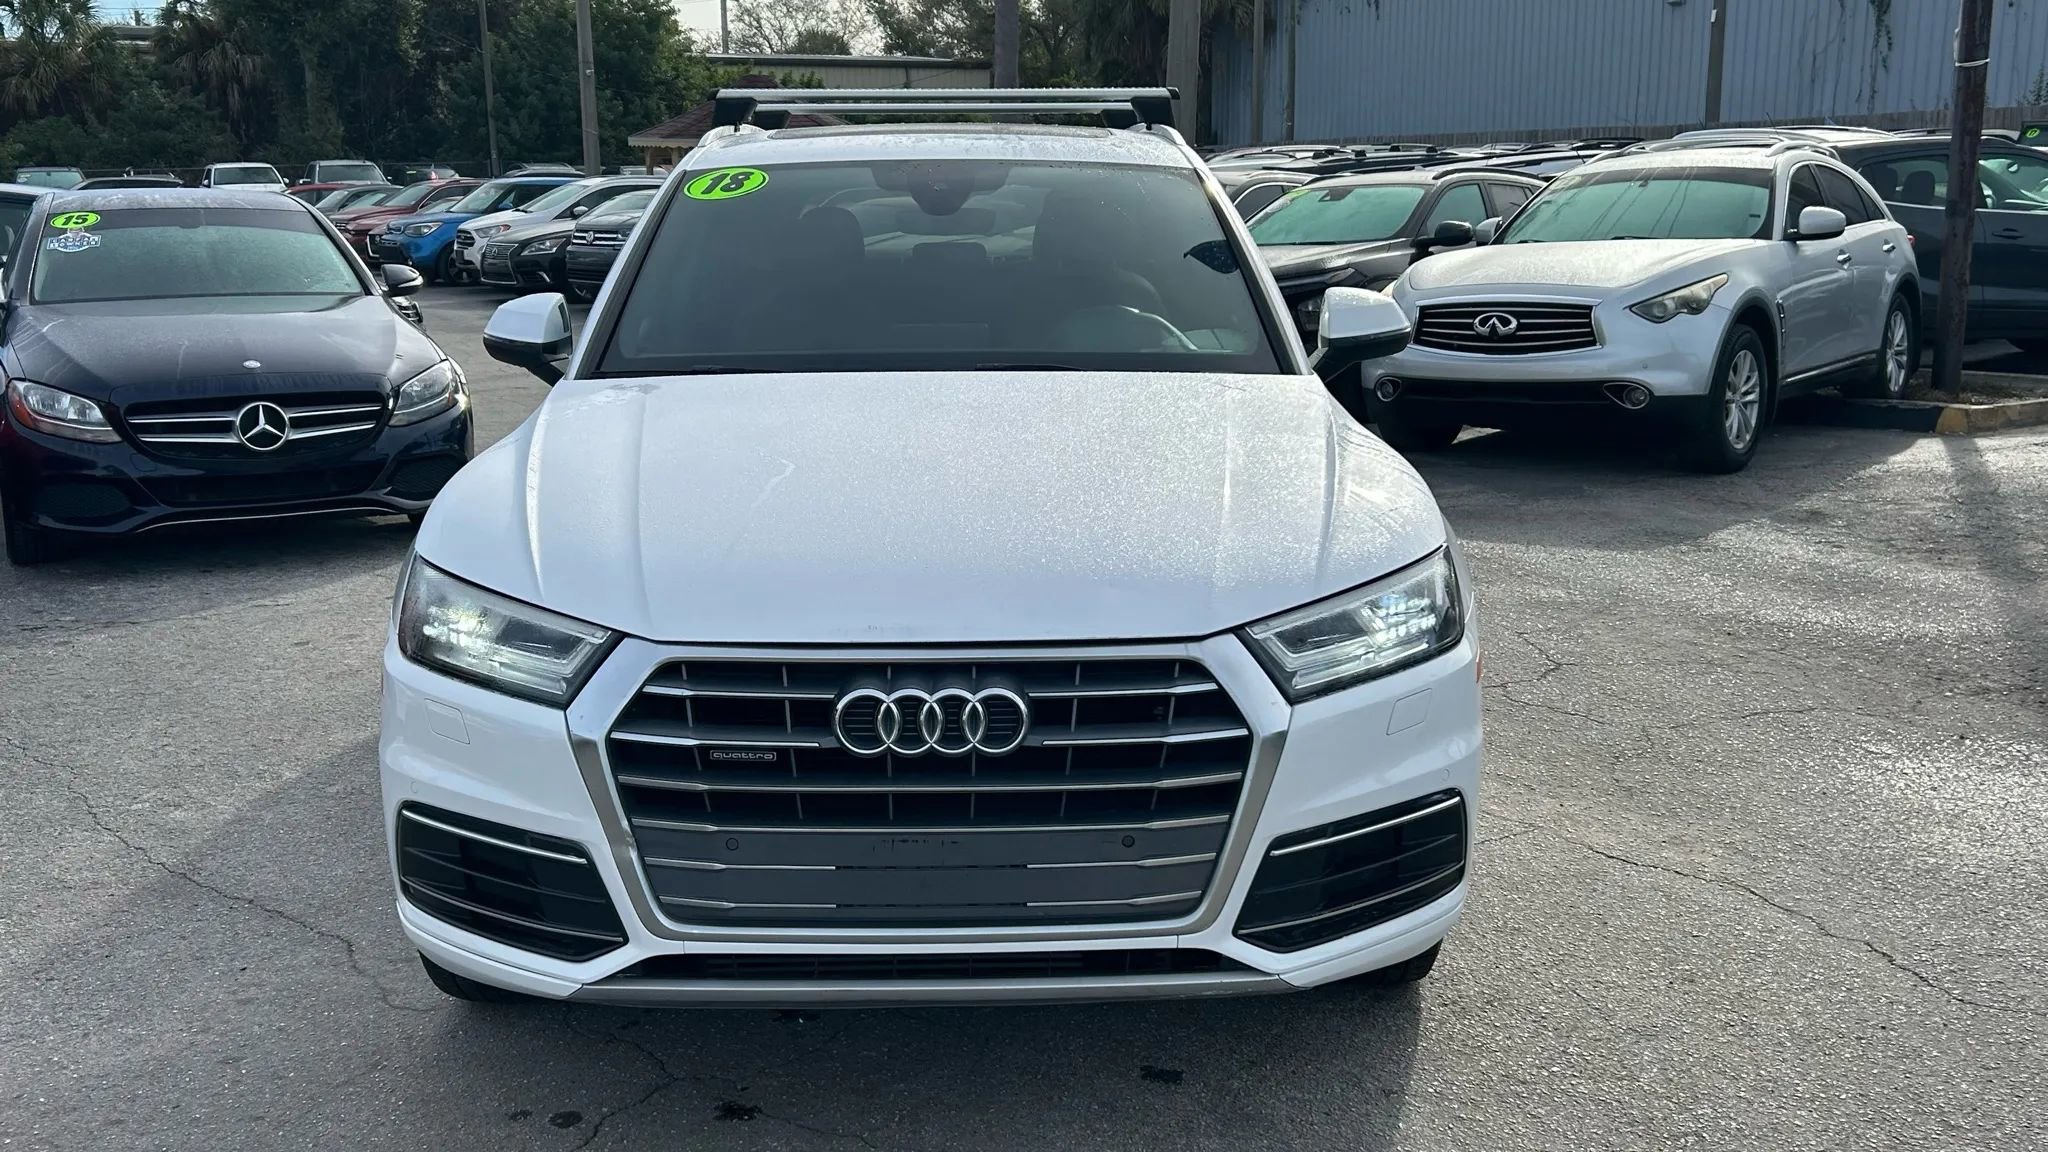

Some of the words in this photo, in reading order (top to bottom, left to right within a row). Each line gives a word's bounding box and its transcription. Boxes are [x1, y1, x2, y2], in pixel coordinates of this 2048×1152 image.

[701, 171, 754, 195] 18
[61, 214, 89, 226] 15
[712, 752, 774, 760] quattro
